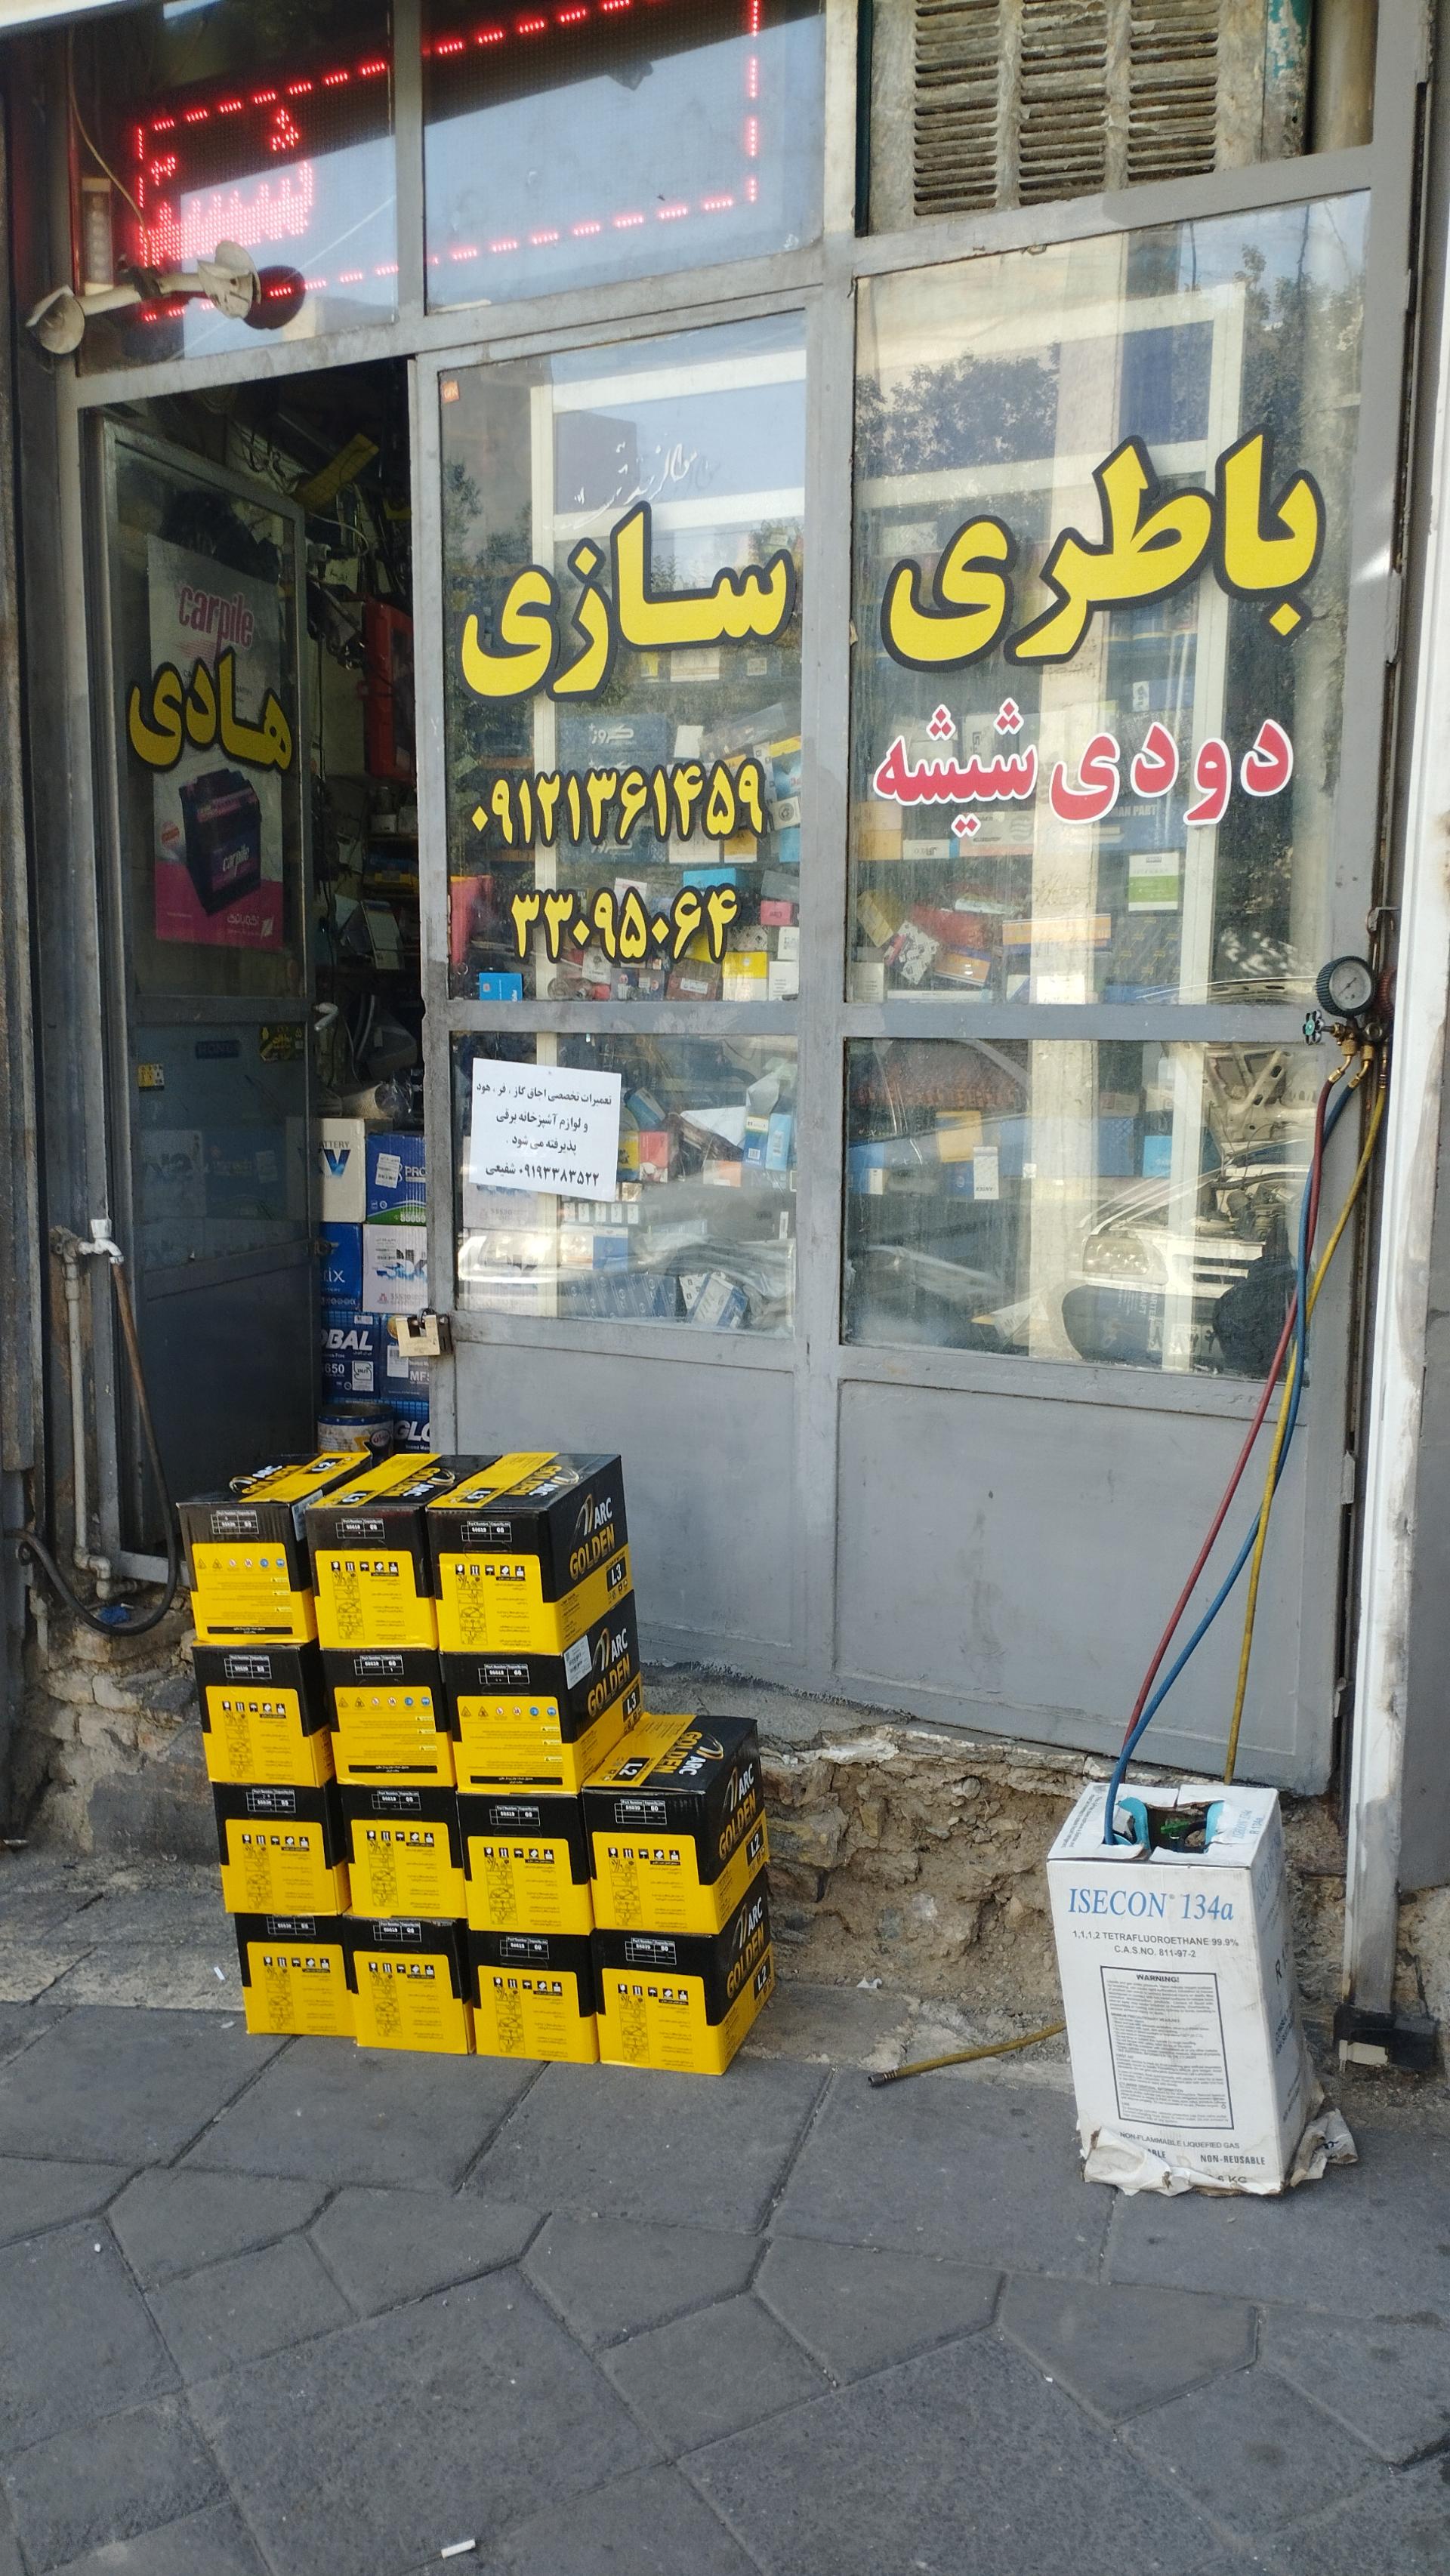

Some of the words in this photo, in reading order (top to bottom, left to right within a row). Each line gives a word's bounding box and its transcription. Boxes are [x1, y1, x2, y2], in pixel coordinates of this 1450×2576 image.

[881, 424, 1325, 673] باطری
[457, 500, 796, 707] سازی
[178, 585, 255, 658] carpile
[127, 646, 295, 773] هادی
[873, 698, 1038, 838] شیشه
[1049, 719, 1294, 824] دودی
[470, 758, 770, 848] ۰۹۱۲۱۳۶۱۴۵۹
[508, 883, 742, 963] ۳۳۰۹۵۰۶۴
[477, 1083, 491, 1094] هود
[527, 1086, 547, 1100] اجاق
[548, 1091, 580, 1102] تخصصی
[581, 1093, 612, 1107] تعمیرات
[496, 1108, 517, 1123] برقی
[559, 1117, 582, 1132] لوازم
[583, 1123, 588, 1132] و
[545, 1138, 577, 1155] پذیرفته
[594, 1497, 612, 1530] ARC
[569, 1523, 615, 1581] GOLDEN
[611, 1564, 622, 1586] L3
[611, 1628, 628, 1662] ARC
[588, 1653, 631, 1717] GOLDEN
[627, 1692, 637, 1715] L3
[653, 1731, 702, 1773] GOLDEN
[619, 1763, 643, 1776] L2
[679, 1755, 706, 1776] ARC
[739, 1764, 754, 1801] ARC
[719, 1788, 756, 1861] GOLDEN
[750, 1833, 760, 1858] L2
[748, 1897, 763, 1937] ARC
[1068, 1887, 1167, 1918] ISECON
[1180, 1893, 1234, 1921] 134a
[1103, 1932, 1209, 1946] TETRAFLUOROETHANE
[1211, 1938, 1239, 1947] 99.9%
[727, 1921, 764, 1999] GOLDEN
[1158, 1948, 1196, 1958] 811-97-2
[757, 1965, 767, 1991] L2
[1136, 1974, 1180, 1983] WARNING!
[1119, 2131, 1182, 2147] NON-FLAMMABLE
[1183, 2140, 1222, 2149] LIQUEFIED
[1200, 2154, 1266, 2165] NON-REUSABLE
